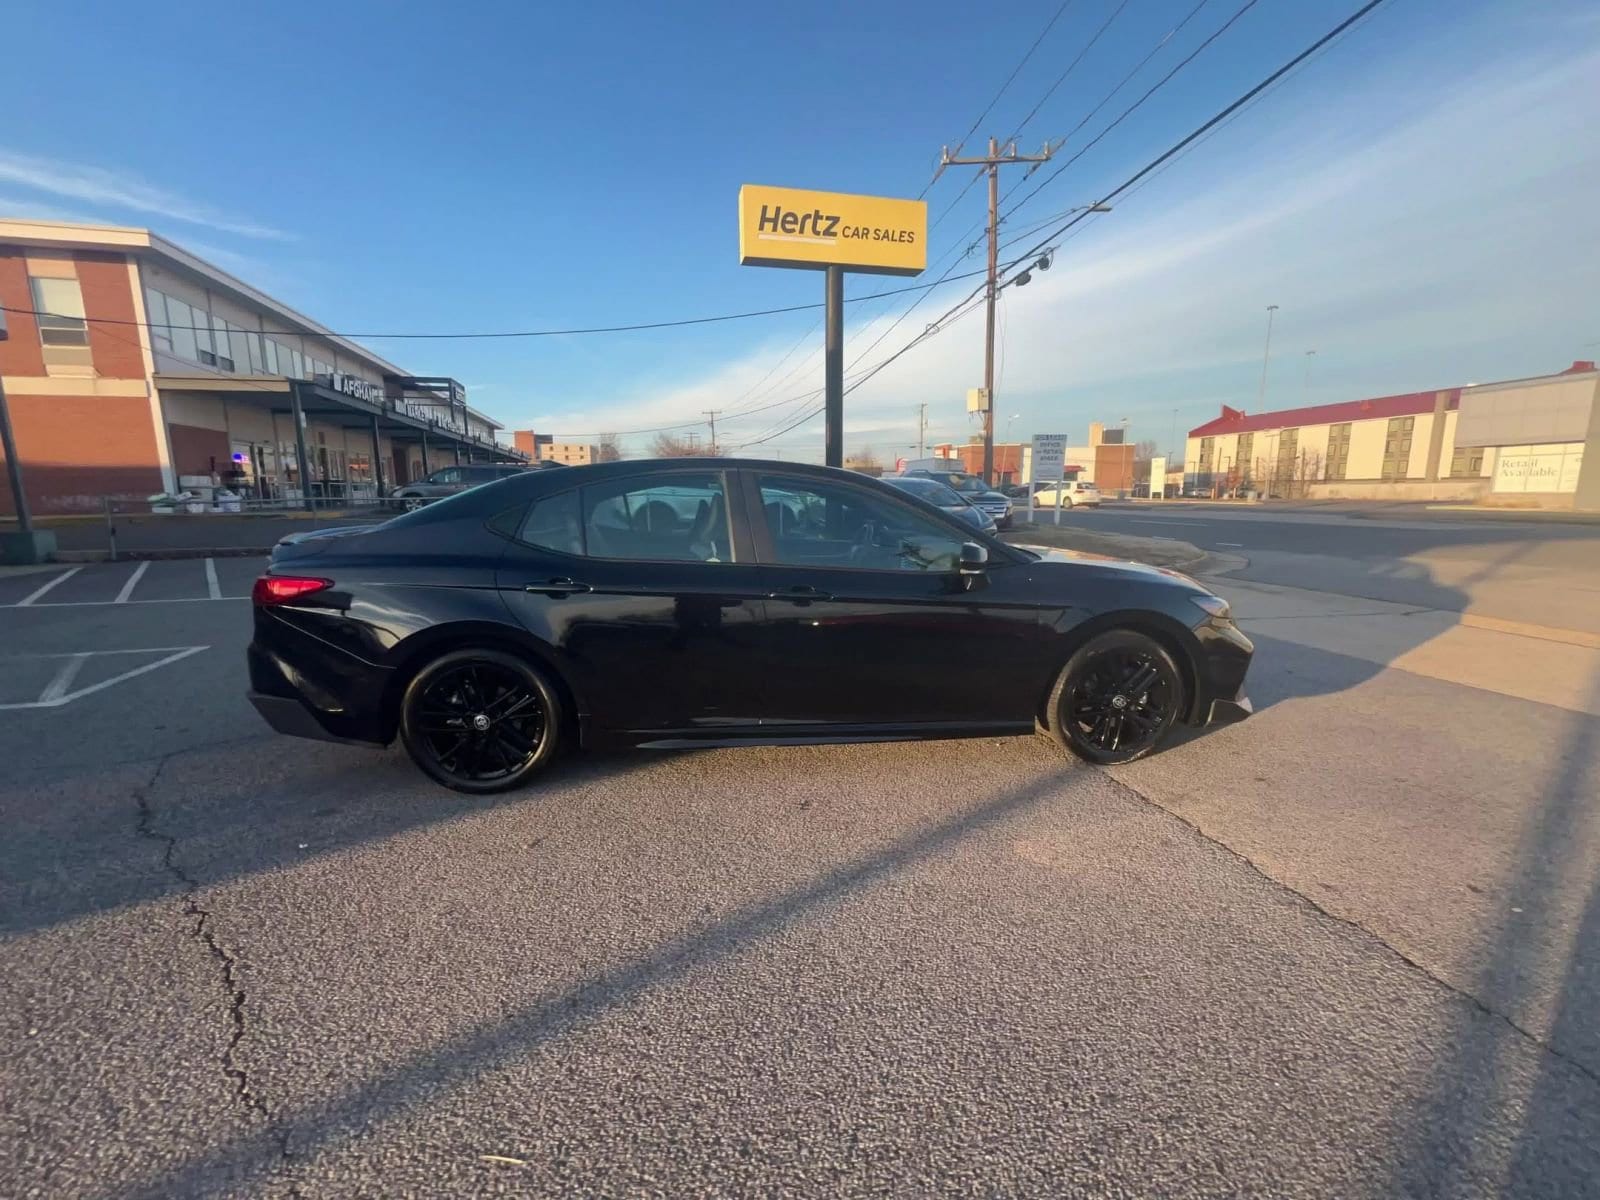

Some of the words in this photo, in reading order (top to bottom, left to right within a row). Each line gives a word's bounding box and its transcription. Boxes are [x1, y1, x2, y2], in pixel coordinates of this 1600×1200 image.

[758, 204, 841, 237] Hertz
[842, 225, 869, 240] CAR
[873, 228, 914, 243] SALES
[1502, 457, 1538, 468] Retail
[1501, 466, 1558, 477] Available
